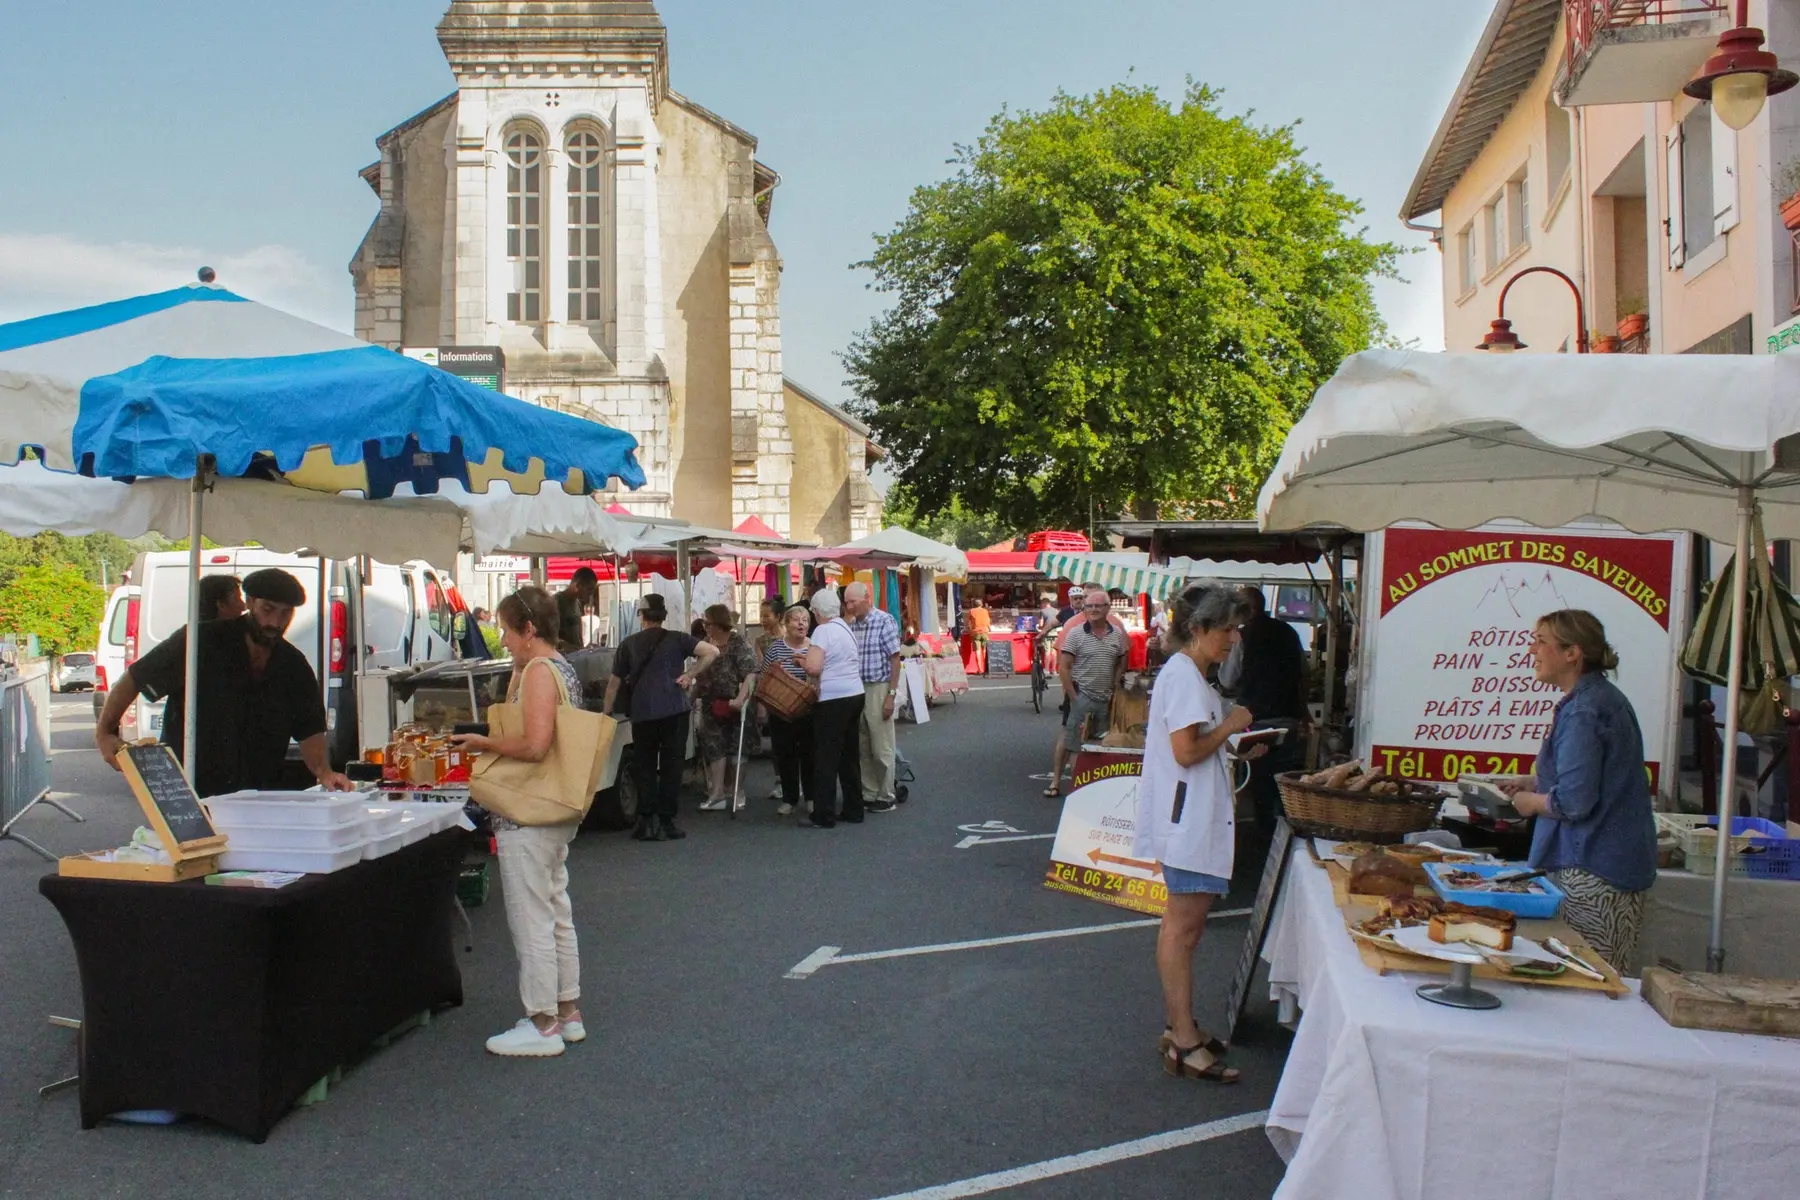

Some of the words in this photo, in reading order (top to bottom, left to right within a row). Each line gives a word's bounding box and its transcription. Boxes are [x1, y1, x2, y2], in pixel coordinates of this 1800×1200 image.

[440, 352, 493, 362] Informations
[478, 558, 513, 568] mairie
[1389, 572, 1418, 603] AU
[1419, 540, 1514, 581] SOMMET
[1520, 541, 1566, 563] DES
[1570, 550, 1667, 616] SAVEURS
[1468, 626, 1537, 647] RÔTISS
[1432, 653, 1484, 670] PAIN
[1506, 653, 1536, 669] SA
[1471, 676, 1563, 693] BOISSON
[1424, 696, 1483, 717] PLÂTS
[1487, 696, 1501, 717] À
[1508, 699, 1555, 717] EMP
[1414, 724, 1516, 741] PRODUITS
[1074, 770, 1090, 787] AU
[1093, 762, 1143, 780] SOMMET
[1380, 750, 1432, 779] Tél.
[1443, 753, 1477, 780] 06
[1487, 756, 1519, 775] 24
[1100, 815, 1135, 831] RÔTISSERI
[1055, 863, 1078, 882] Tél.
[1083, 869, 1101, 887] 06
[1103, 874, 1124, 892] 24
[1127, 878, 1146, 897] 65
[1150, 883, 1168, 902] 60
